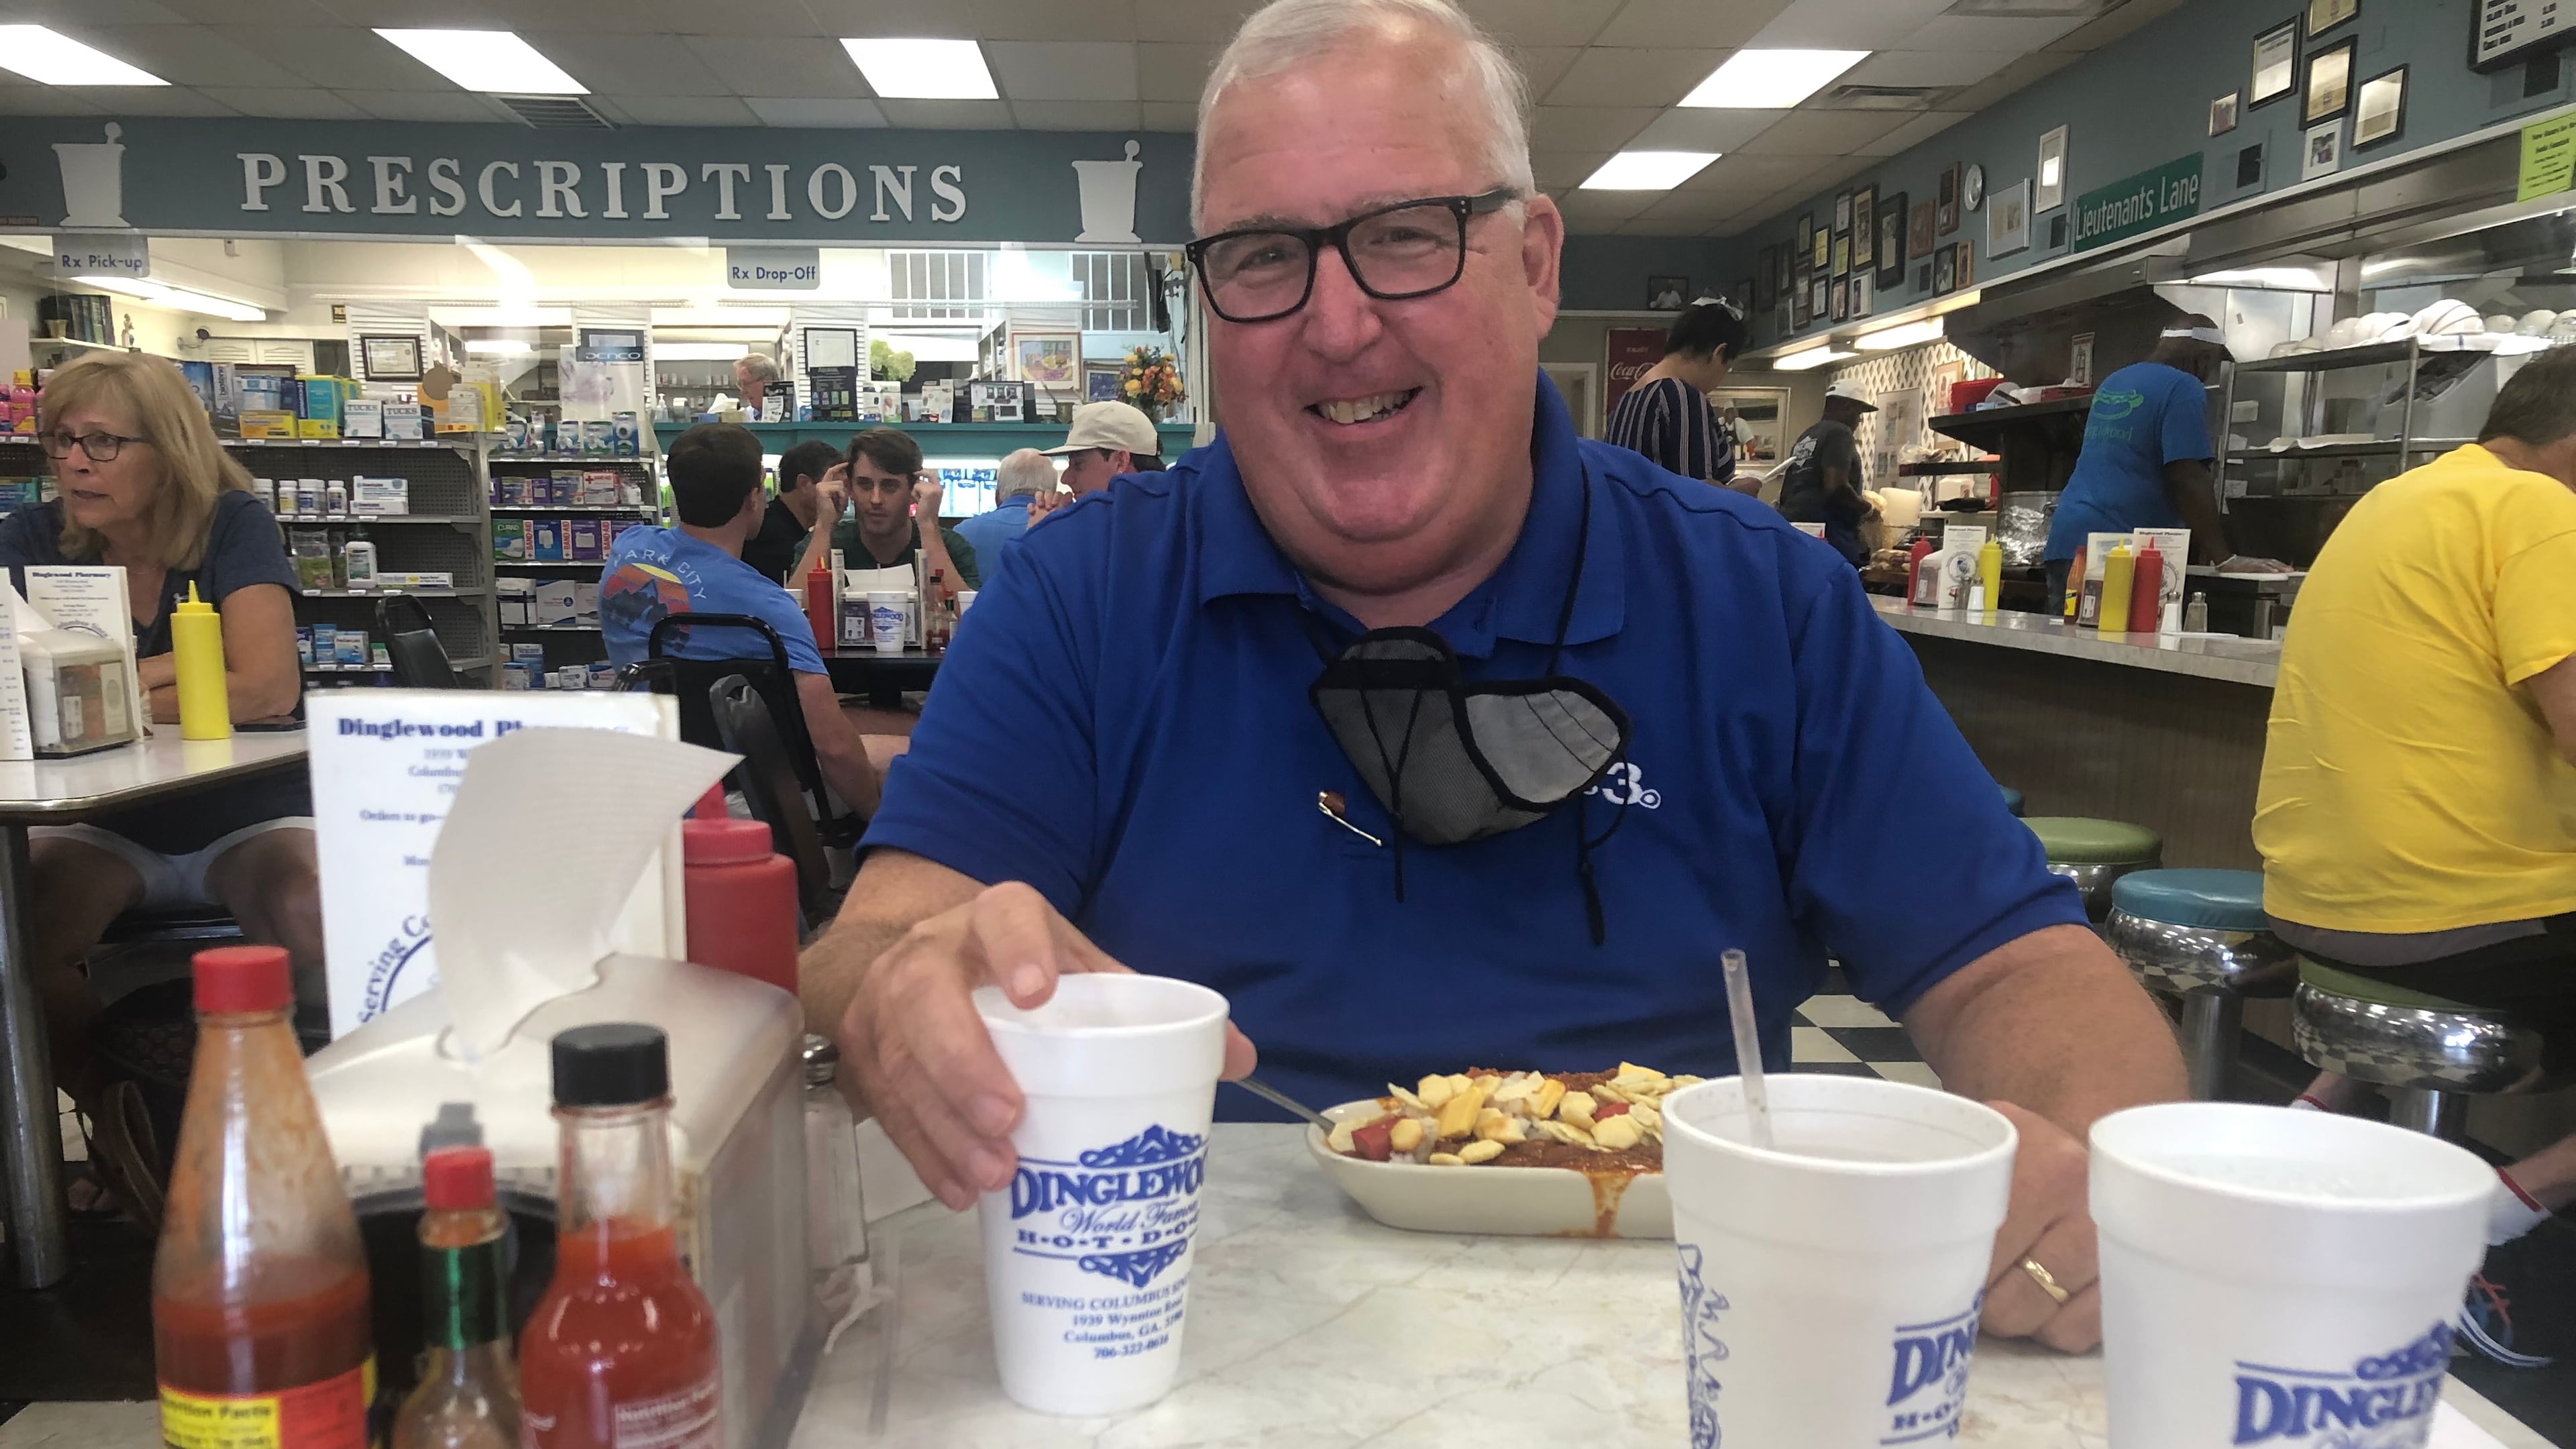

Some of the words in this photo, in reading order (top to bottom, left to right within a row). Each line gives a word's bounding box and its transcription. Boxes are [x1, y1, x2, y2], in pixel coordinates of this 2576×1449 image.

[236, 152, 967, 223] PRESCRIPTIONS
[2076, 186, 2155, 241] Lieutenants
[2160, 174, 2199, 214] Lane
[62, 254, 81, 268] Rx
[89, 254, 142, 271] Pick-up
[732, 266, 749, 279] Rx
[756, 266, 816, 283] Drop-Off
[678, 561, 707, 599] CITY
[339, 718, 483, 739] Dinglewood
[358, 938, 407, 1022] Serving
[1060, 1204, 1142, 1234] World
[1022, 1291, 1086, 1309] SERVING
[1089, 1285, 1171, 1309] COLUMBUS
